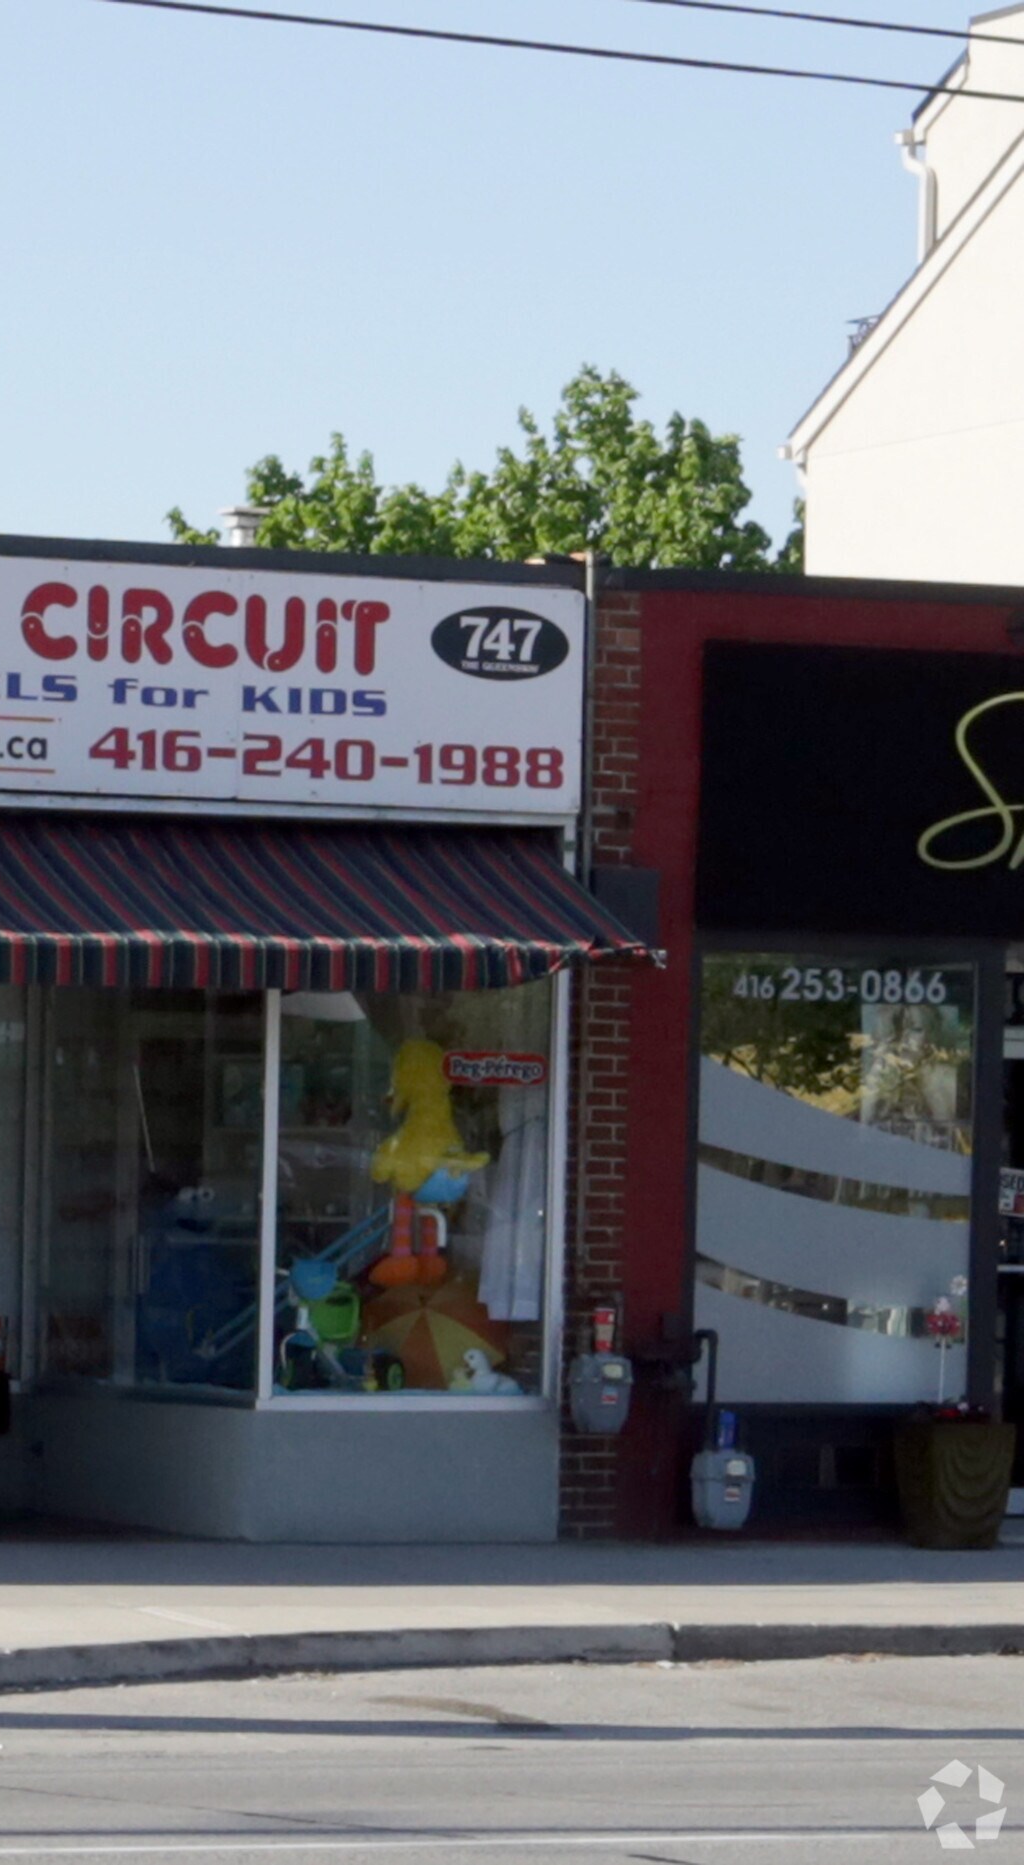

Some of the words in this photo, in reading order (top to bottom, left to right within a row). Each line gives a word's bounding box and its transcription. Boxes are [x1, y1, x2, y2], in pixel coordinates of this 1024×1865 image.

[19, 581, 392, 677] CIRCUIT
[459, 615, 543, 662] 747
[107, 677, 210, 710] for
[241, 684, 388, 717] KIDS
[88, 726, 564, 790] 416-240-1988
[733, 974, 776, 999] 416
[779, 967, 947, 1004] 253-0866
